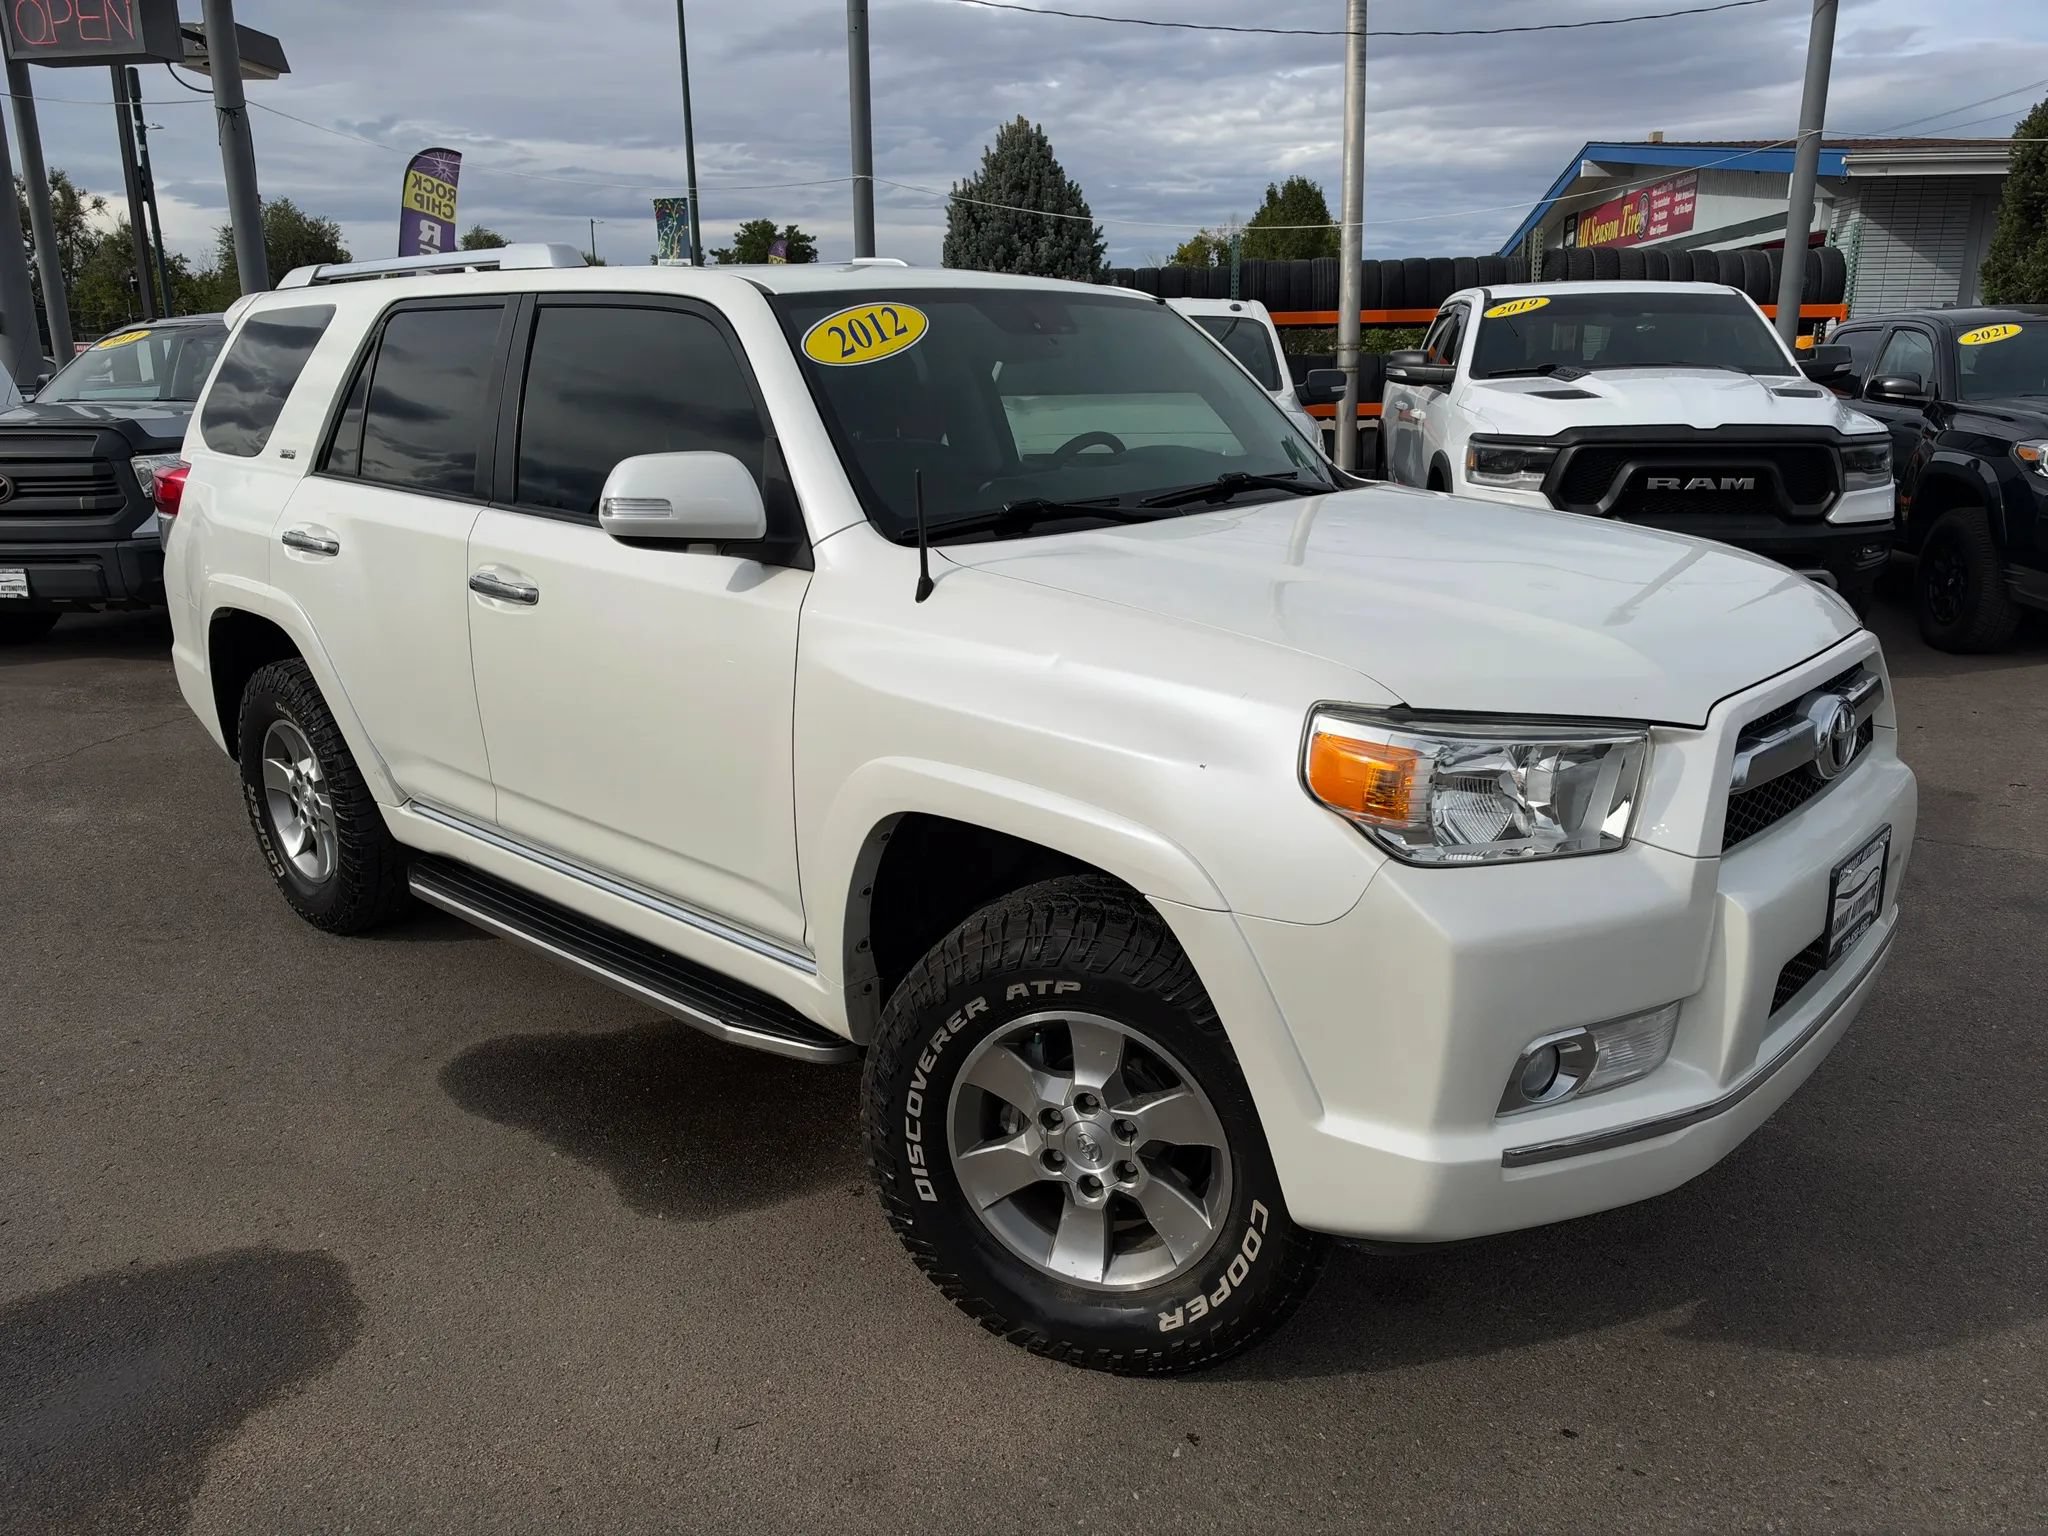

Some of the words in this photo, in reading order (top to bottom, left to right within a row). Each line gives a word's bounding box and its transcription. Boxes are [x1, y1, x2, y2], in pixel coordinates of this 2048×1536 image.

[15, 0, 135, 45] OPEN
[1578, 217, 1591, 248] All
[1589, 215, 1619, 246] Season
[1620, 203, 1642, 237] Tire
[1496, 299, 1539, 316] 2019
[827, 307, 908, 358] 2012
[1970, 325, 2009, 343] 2021
[1647, 477, 1755, 490] RAM
[247, 783, 285, 878] COOPER
[905, 996, 989, 1202] DISCOVERER
[1006, 980, 1081, 1001] ATP
[1157, 1199, 1269, 1333] COOPER
